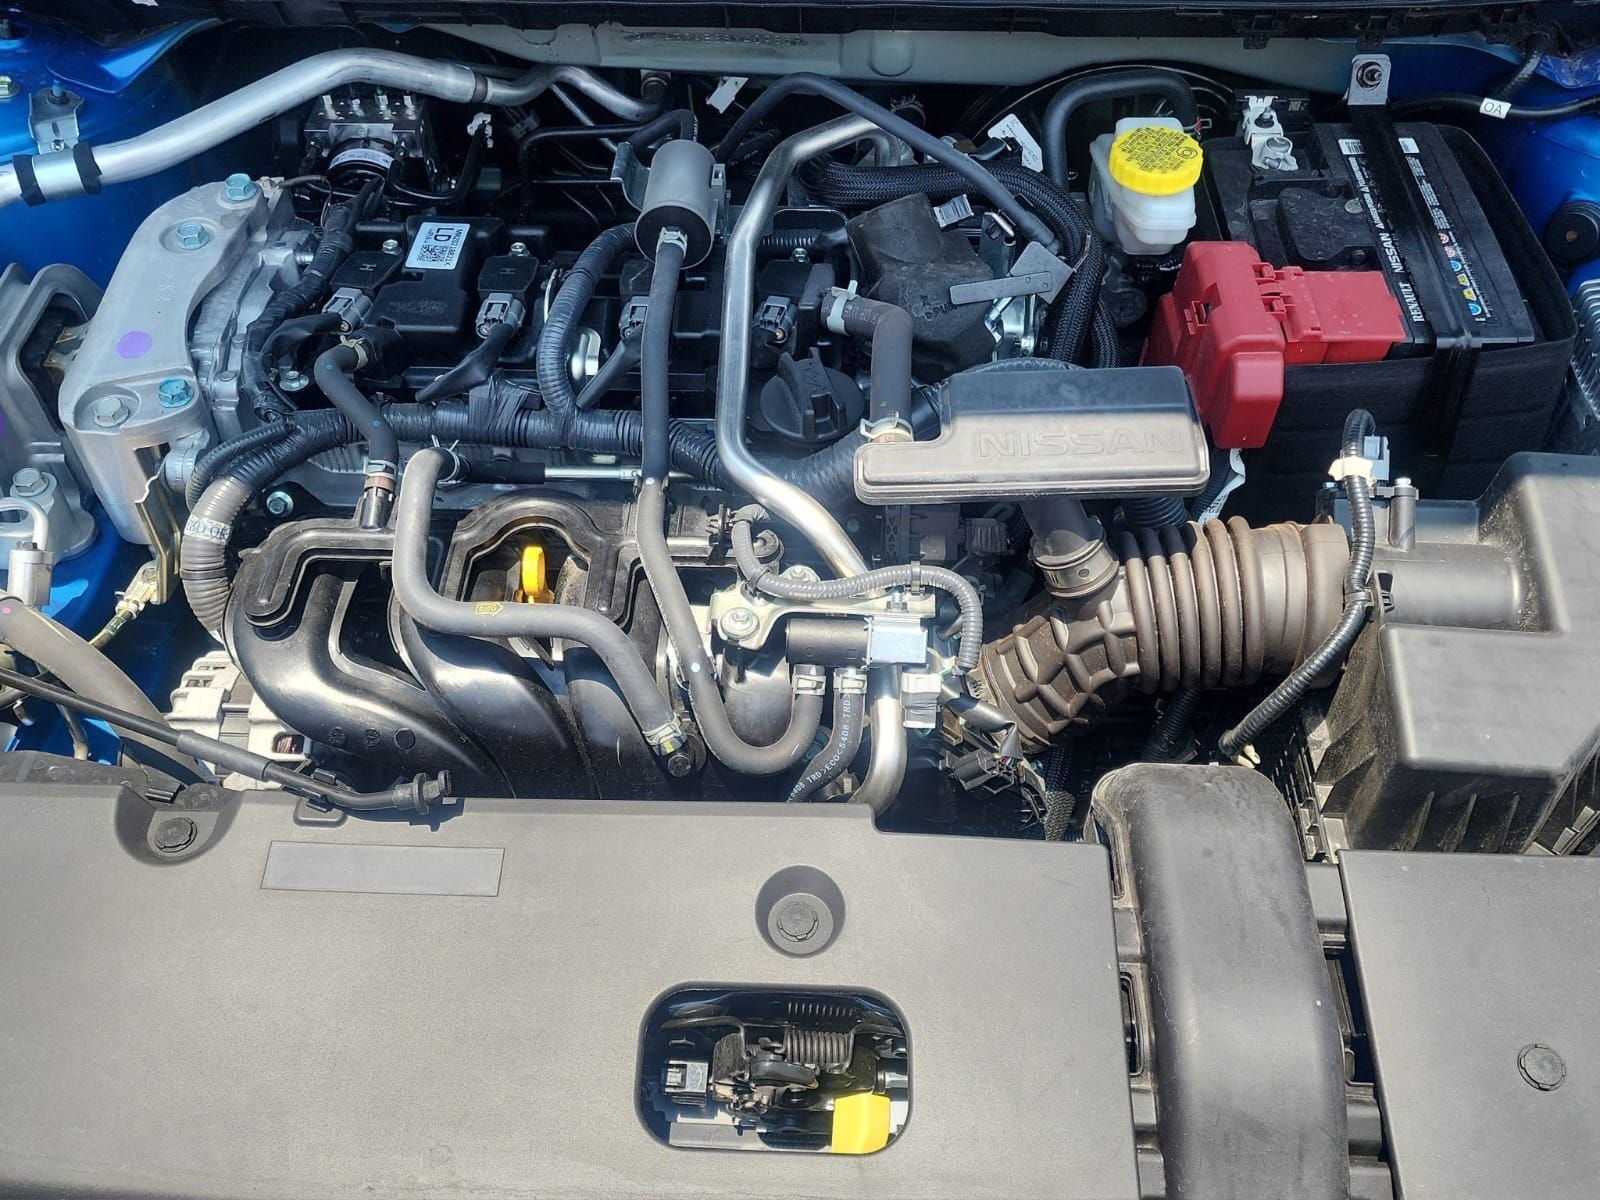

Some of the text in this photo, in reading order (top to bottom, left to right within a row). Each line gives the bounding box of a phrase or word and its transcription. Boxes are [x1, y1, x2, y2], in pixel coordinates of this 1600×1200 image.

[1484, 102, 1502, 116] OA
[434, 227, 455, 242] LD
[1379, 232, 1405, 273] NISSAN
[1398, 281, 1425, 322] RENAULT
[977, 427, 1184, 460] NISSAN
